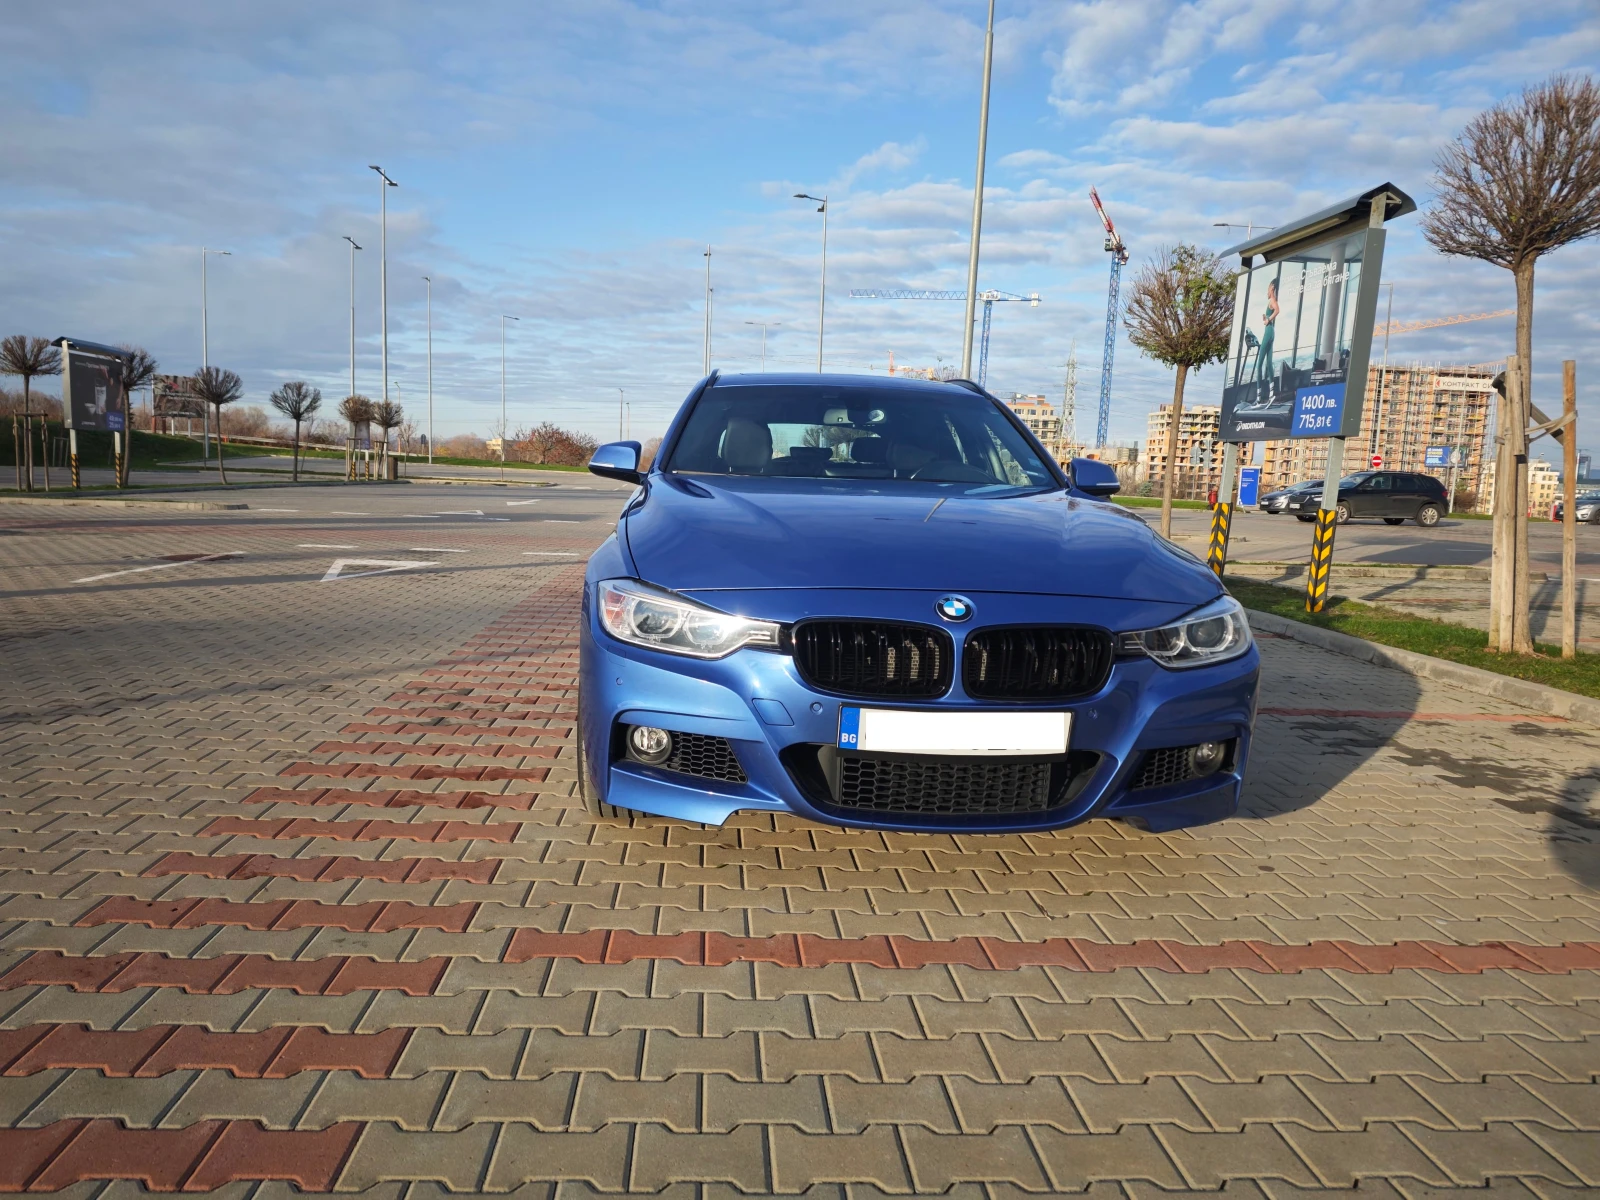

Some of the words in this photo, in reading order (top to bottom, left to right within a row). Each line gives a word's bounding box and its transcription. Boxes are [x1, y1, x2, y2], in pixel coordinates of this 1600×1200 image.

[1302, 394, 1325, 410] 1400
[1325, 398, 1337, 408] лв.
[1299, 413, 1325, 430] 715,81
[1326, 415, 1332, 427] €
[841, 732, 857, 744] BG
